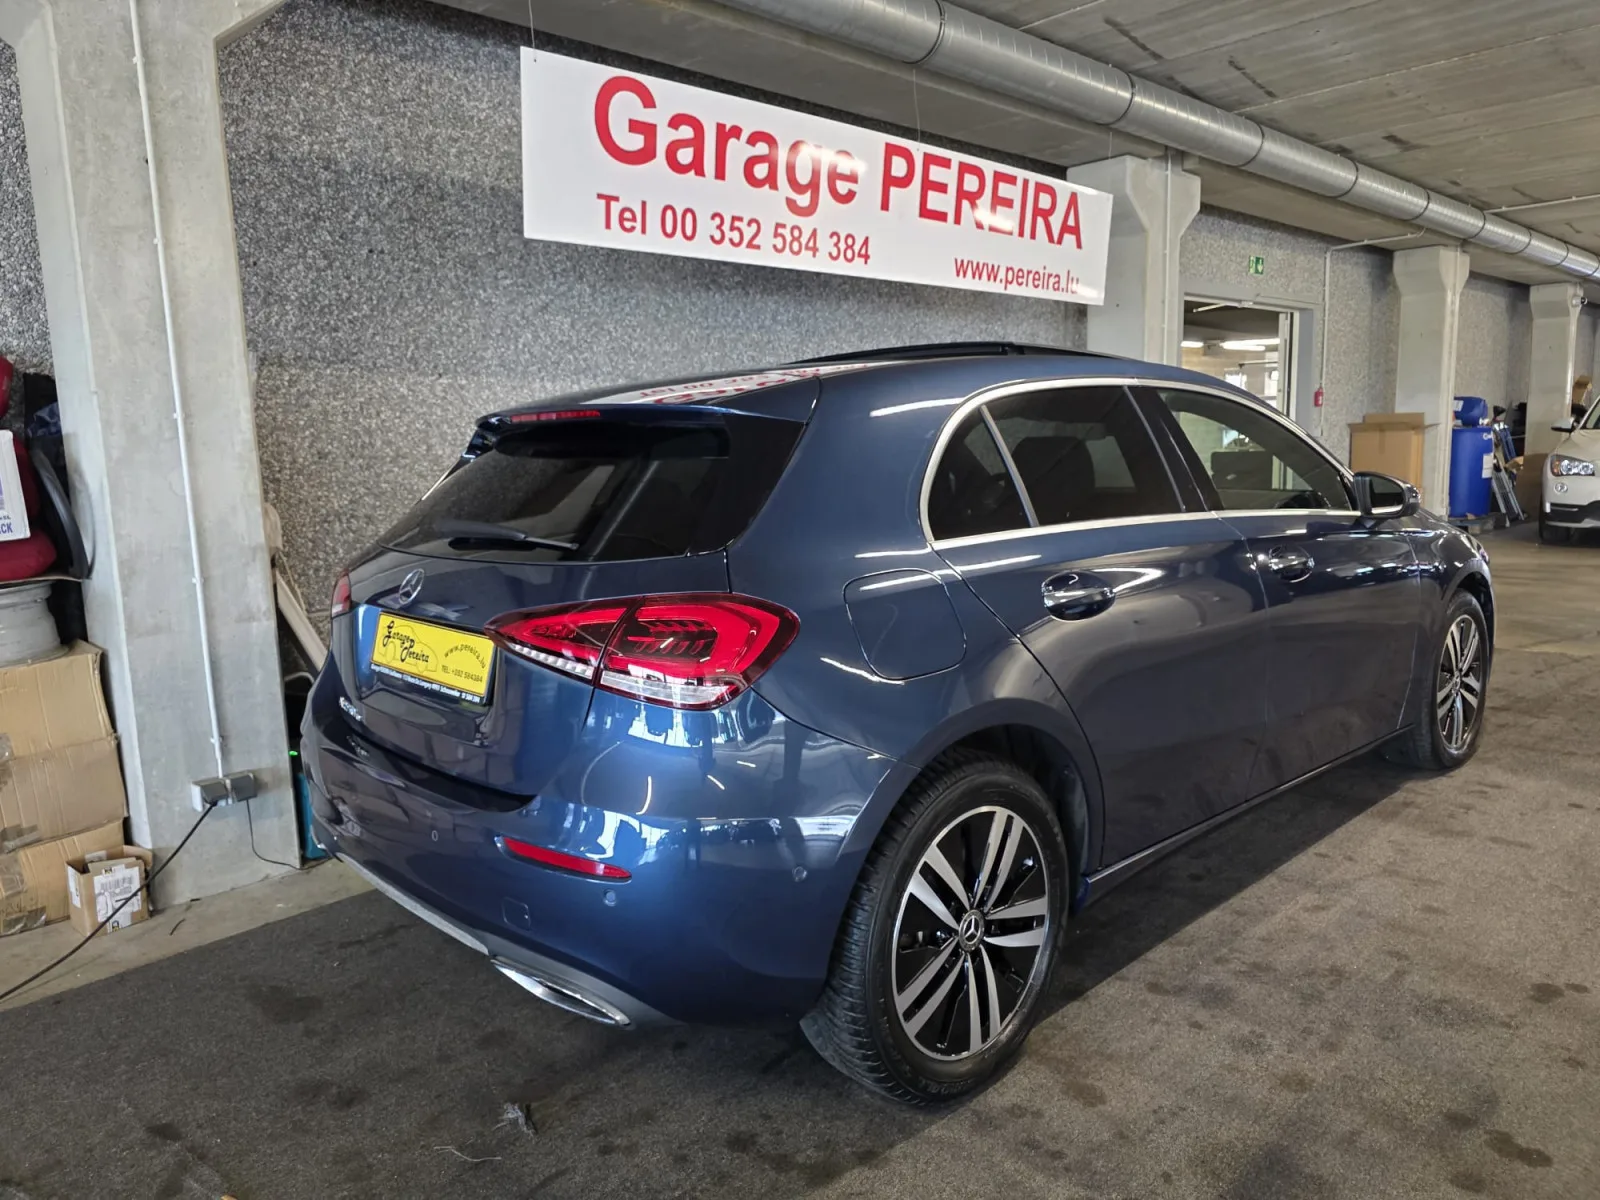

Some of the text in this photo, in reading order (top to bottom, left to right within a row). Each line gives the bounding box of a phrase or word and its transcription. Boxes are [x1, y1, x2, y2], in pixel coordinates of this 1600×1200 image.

[594, 75, 1083, 250] Garage PEREIRA
[596, 192, 870, 265] Tel 00 352 584 384
[954, 257, 1080, 294] www.pereira.lu
[382, 620, 411, 647] Garage
[400, 638, 430, 663] Pereira
